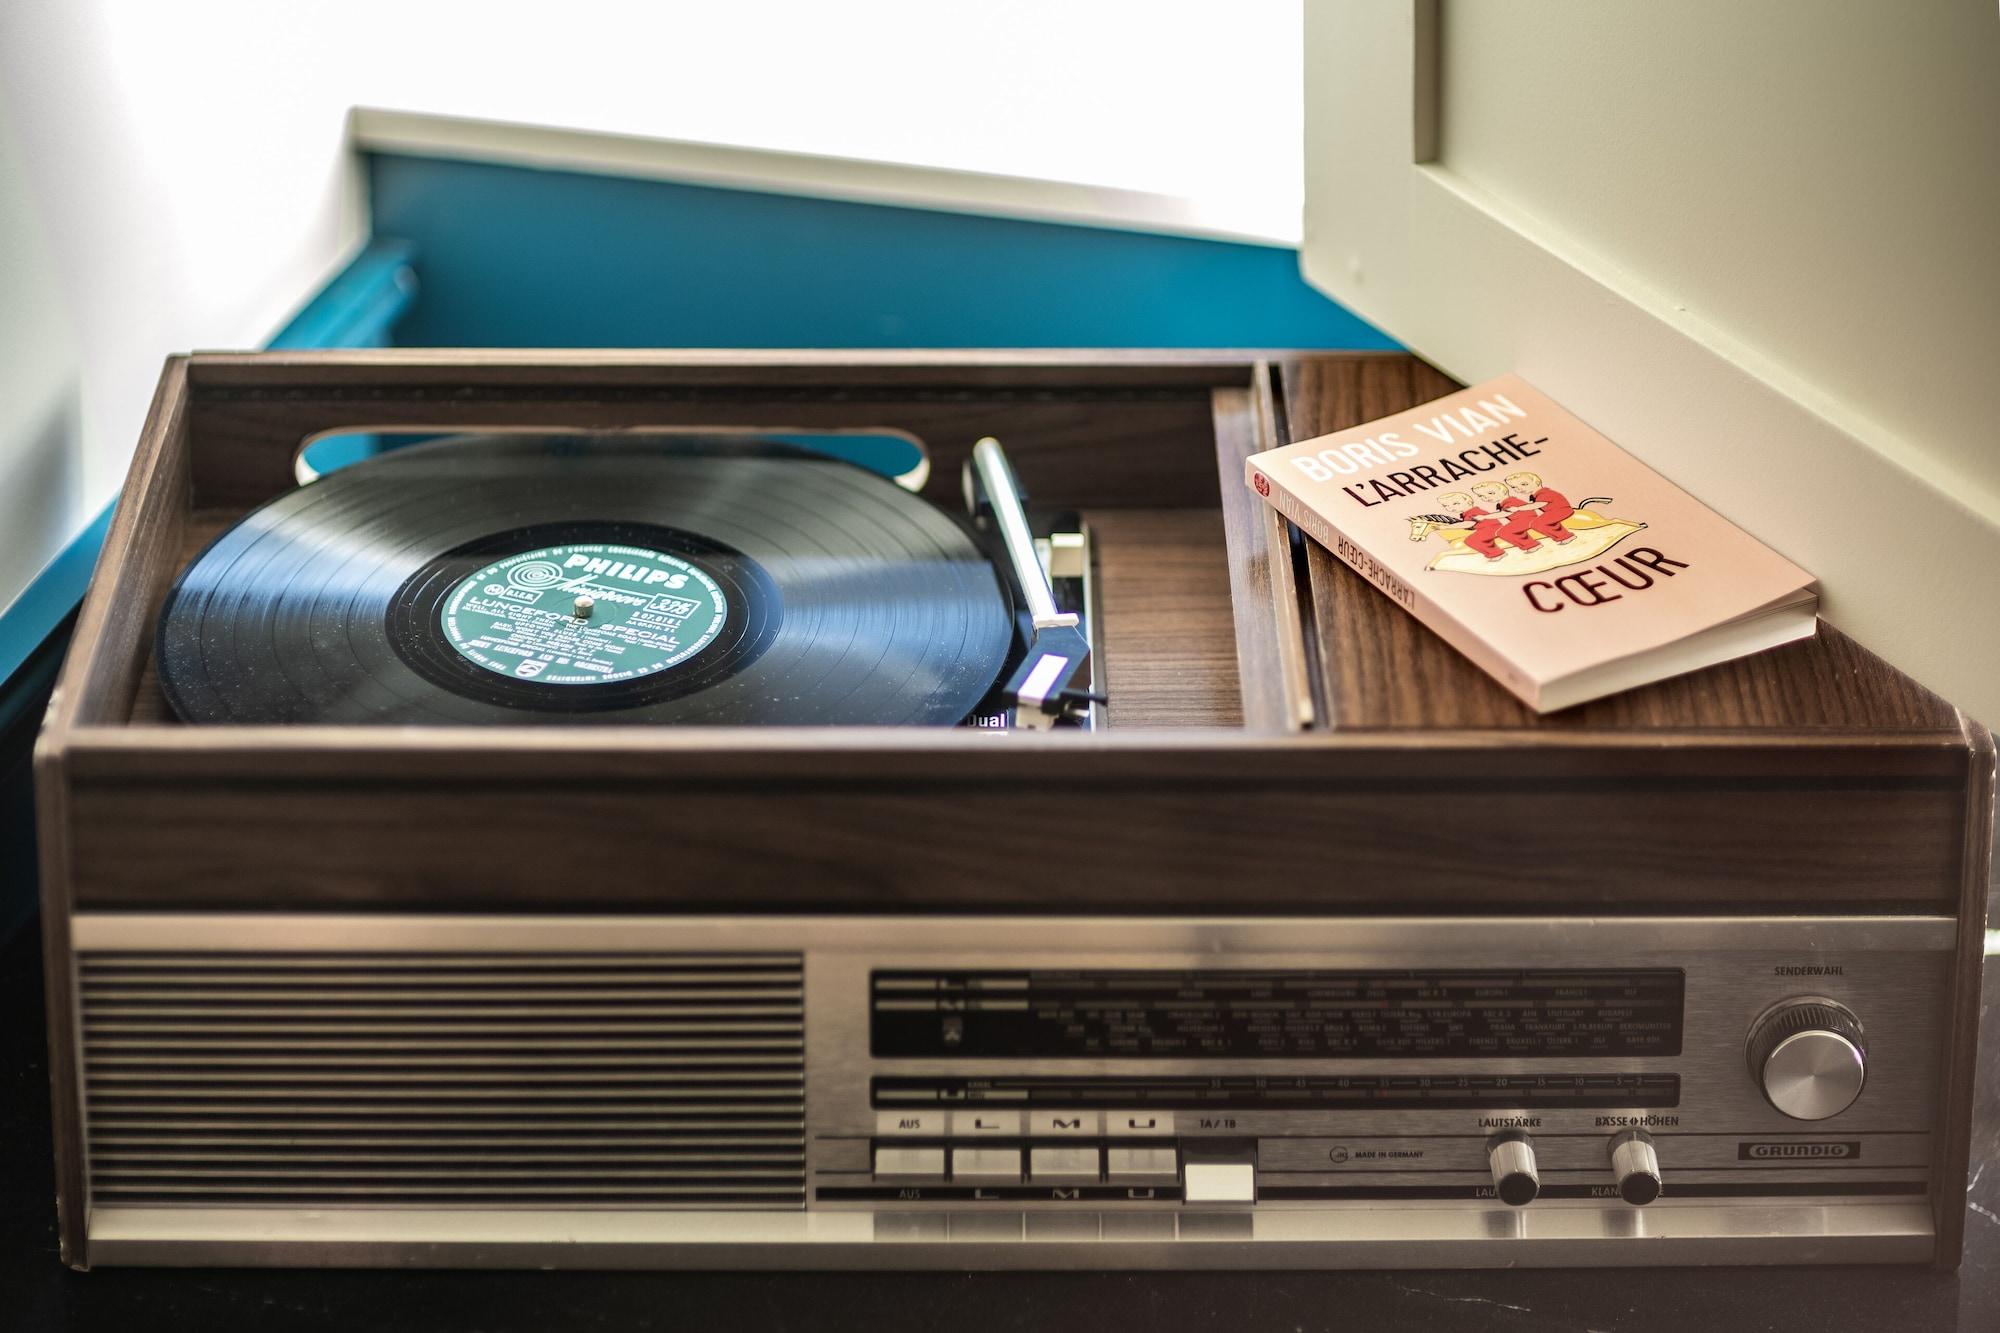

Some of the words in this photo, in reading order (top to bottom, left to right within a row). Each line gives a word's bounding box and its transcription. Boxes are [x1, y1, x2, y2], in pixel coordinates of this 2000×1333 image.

[1290, 431, 1420, 483] BORIS
[1414, 394, 1528, 445] VIAN
[1279, 491, 1300, 522] VIAN
[1303, 509, 1329, 544] BORIS
[563, 553, 689, 589] PHILIPS
[1521, 547, 1690, 613] CŒUR
[469, 596, 589, 625] LUNCEFORD
[600, 623, 680, 645] SPECIAL
[968, 713, 1005, 728] Dual
[1774, 966, 1843, 976] SENDERWAHL
[1420, 1079, 1431, 1087] 30
[1458, 1078, 1469, 1087] 25
[1496, 1078, 1508, 1087] 20
[1537, 1078, 1546, 1086] 15
[1575, 1077, 1585, 1086] 10
[899, 1119, 920, 1129] AUS
[1053, 1119, 1080, 1129] M
[1478, 1116, 1542, 1128] LAUTSTÄRKE
[1595, 1115, 1628, 1127] BÄSSE
[1640, 1114, 1679, 1127] HÖHEN
[1355, 1151, 1376, 1159] MADE
[1378, 1151, 1387, 1159] IN
[1388, 1151, 1424, 1159] GERMANY
[1755, 1145, 1843, 1157] GRUNDIG
[900, 1189, 920, 1199] AUS
[1052, 1189, 1079, 1199] M
